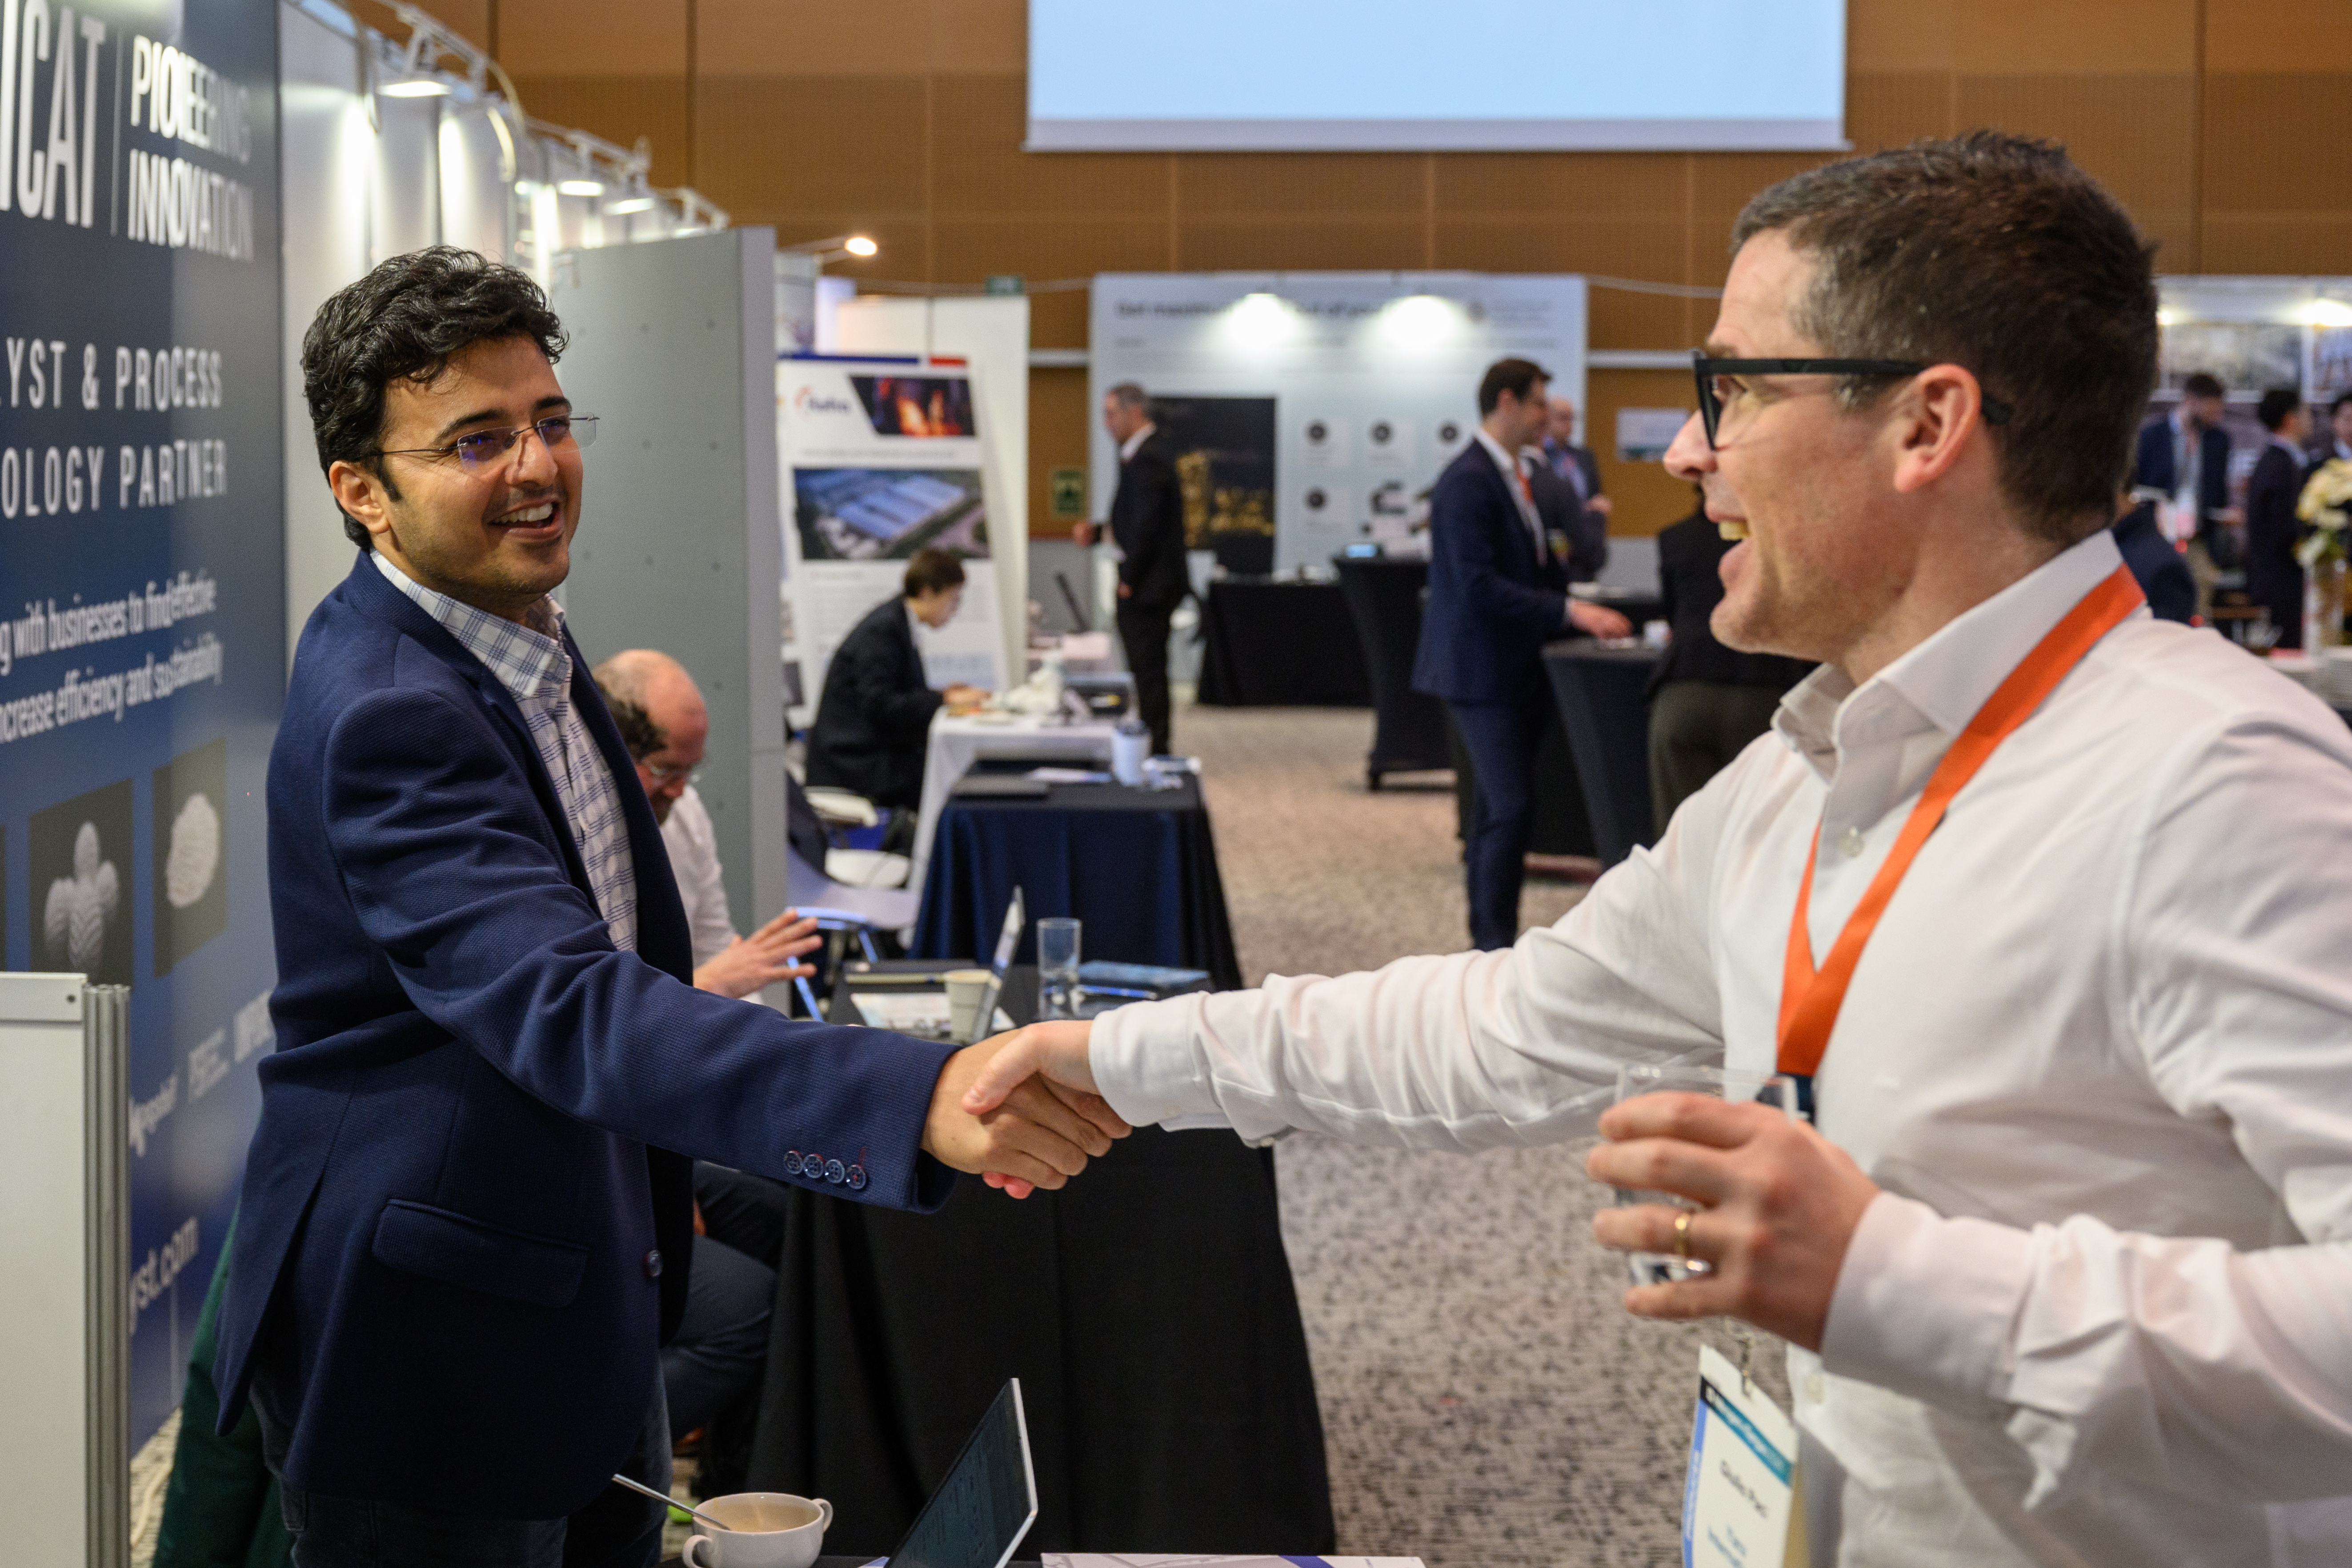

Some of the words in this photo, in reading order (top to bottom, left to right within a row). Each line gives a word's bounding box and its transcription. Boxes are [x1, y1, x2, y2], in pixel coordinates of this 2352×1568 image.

[128, 148, 253, 262] INNOVATION
[6, 337, 66, 408] YST
[81, 343, 100, 410] &
[115, 345, 221, 412] PROCESS
[1, 446, 104, 518] OLOGY
[119, 439, 227, 509] PARTNER
[12, 600, 45, 659] with
[47, 594, 128, 651] businesses
[128, 590, 144, 634] to
[145, 580, 171, 628] find
[0, 690, 54, 743] crease
[56, 667, 124, 726] efficiency
[126, 652, 155, 707] and
